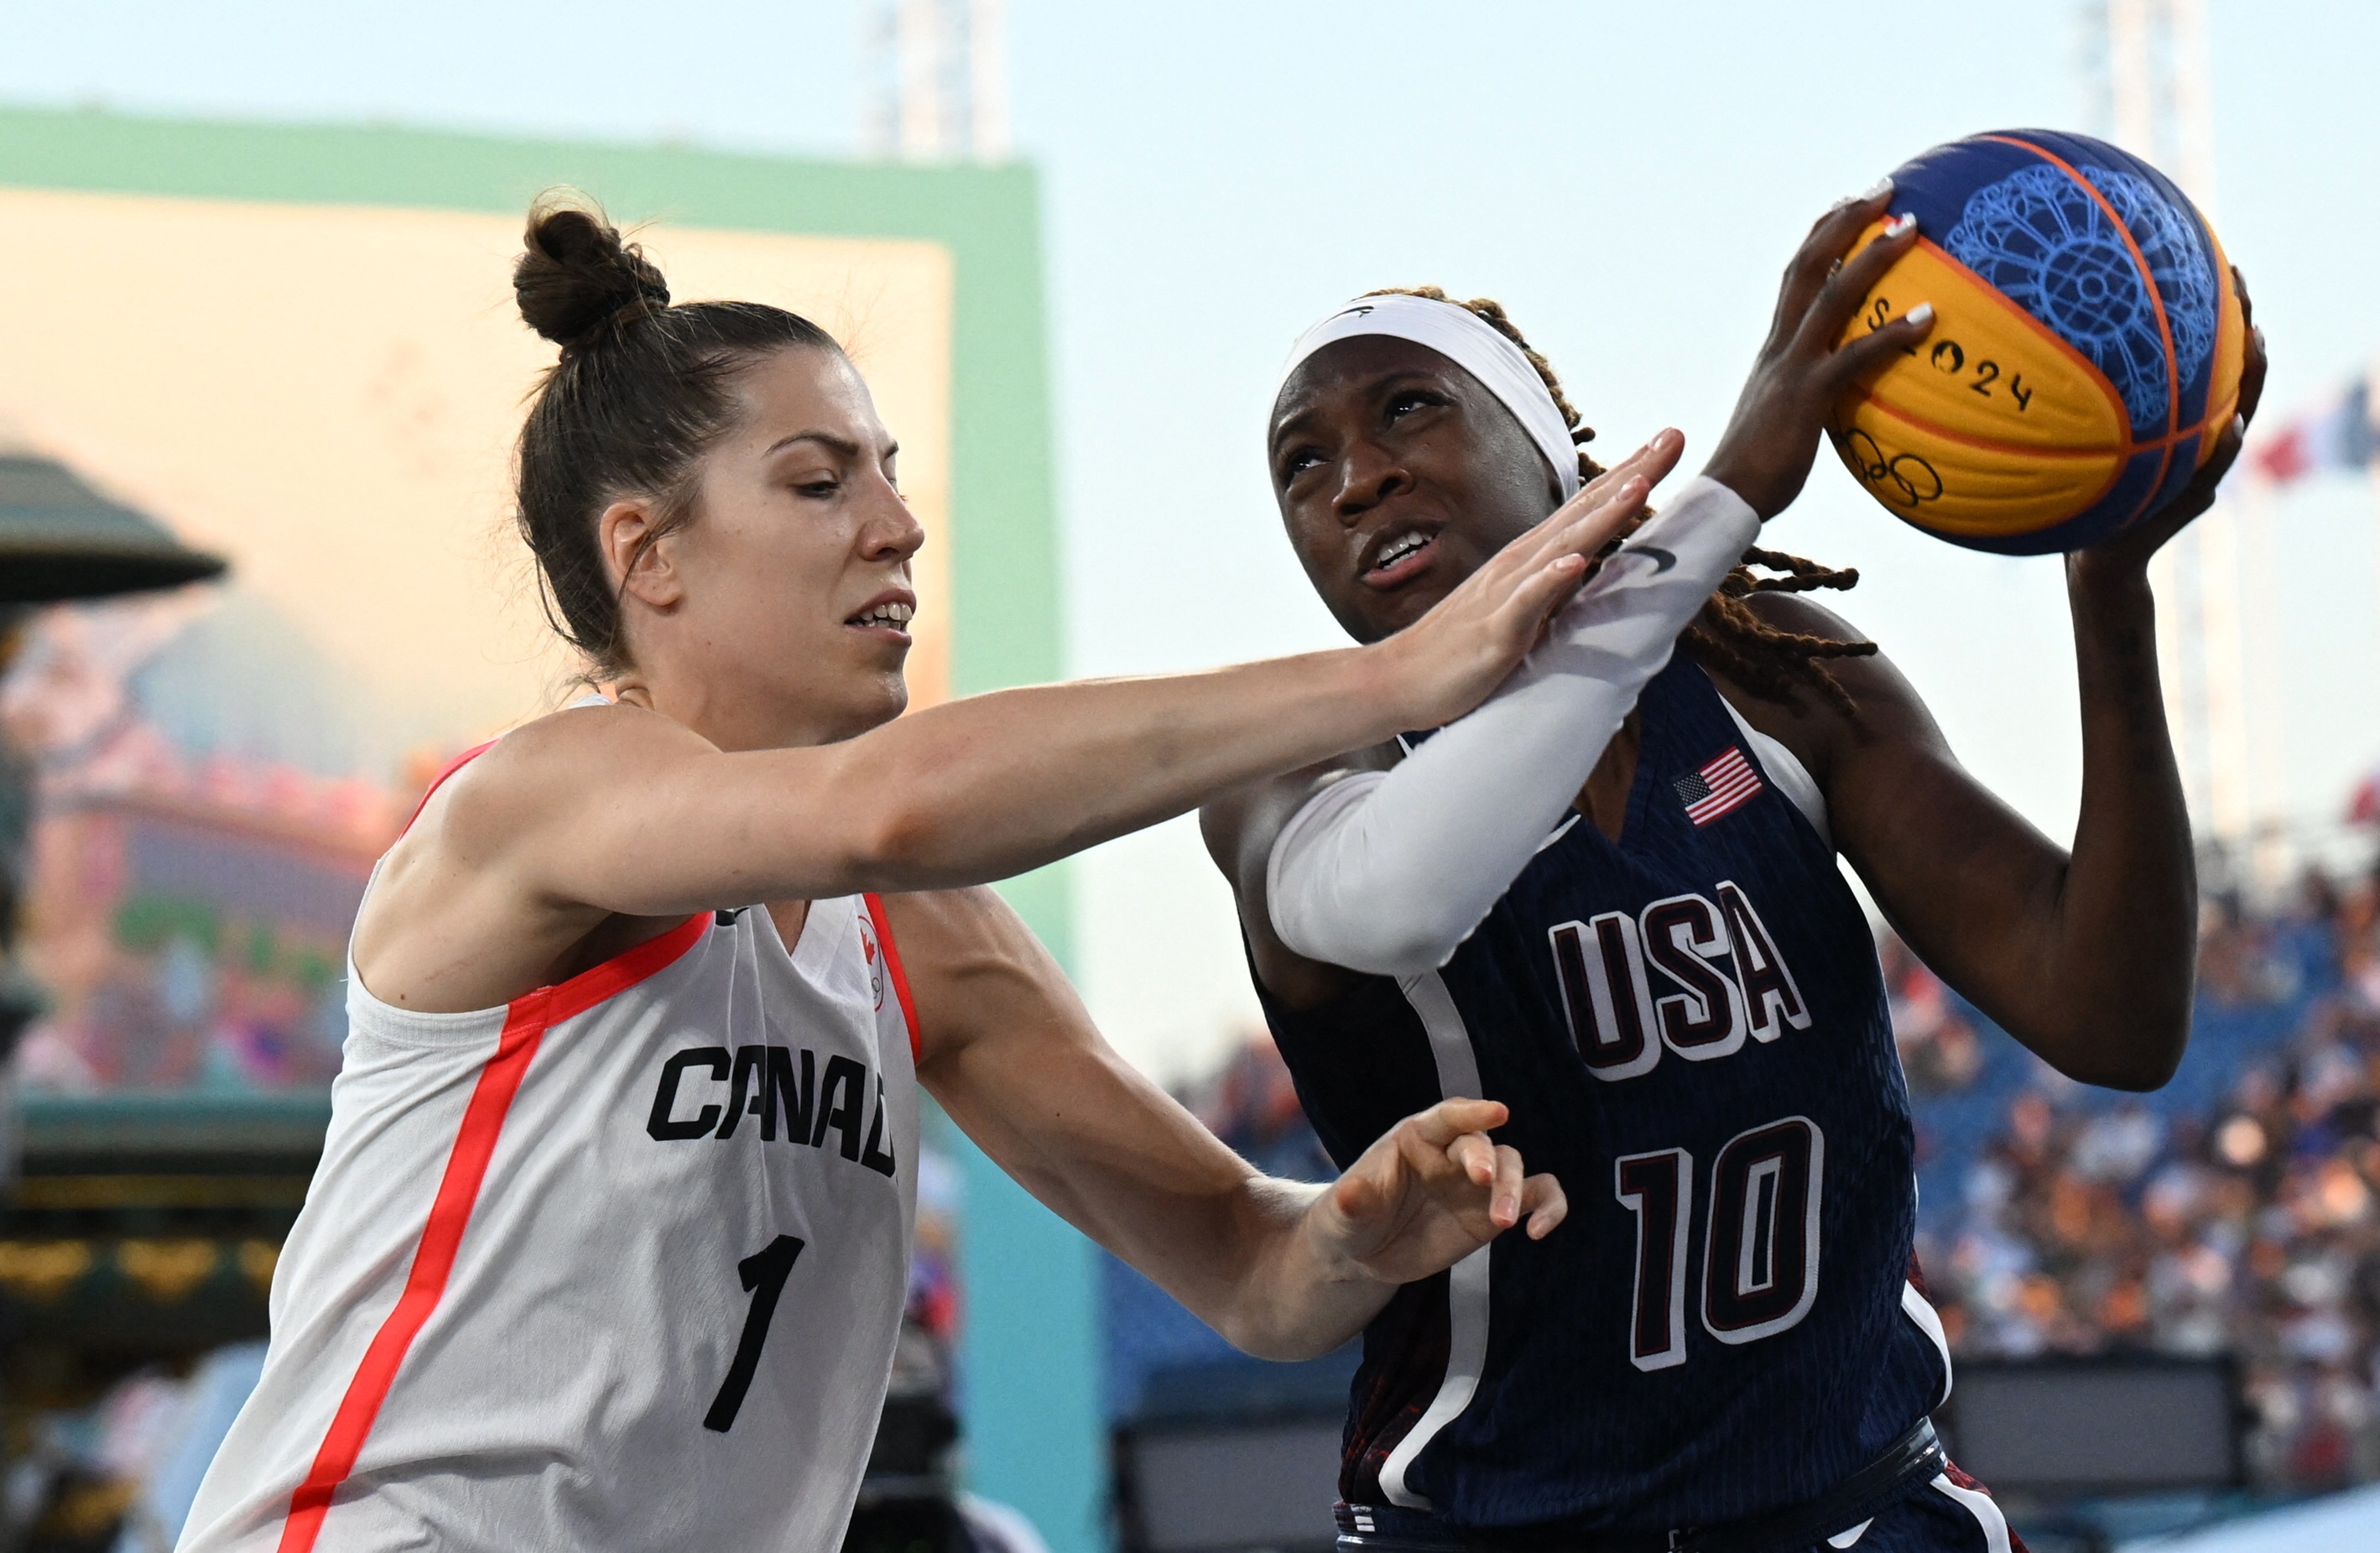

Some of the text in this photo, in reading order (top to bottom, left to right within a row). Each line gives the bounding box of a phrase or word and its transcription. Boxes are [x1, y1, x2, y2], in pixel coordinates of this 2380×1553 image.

[1900, 340, 2032, 411] 024
[1548, 879, 1813, 1081] USA
[646, 1045, 898, 1180] CANAD
[704, 1233, 805, 1433] 1
[1615, 1114, 1825, 1373] 10
